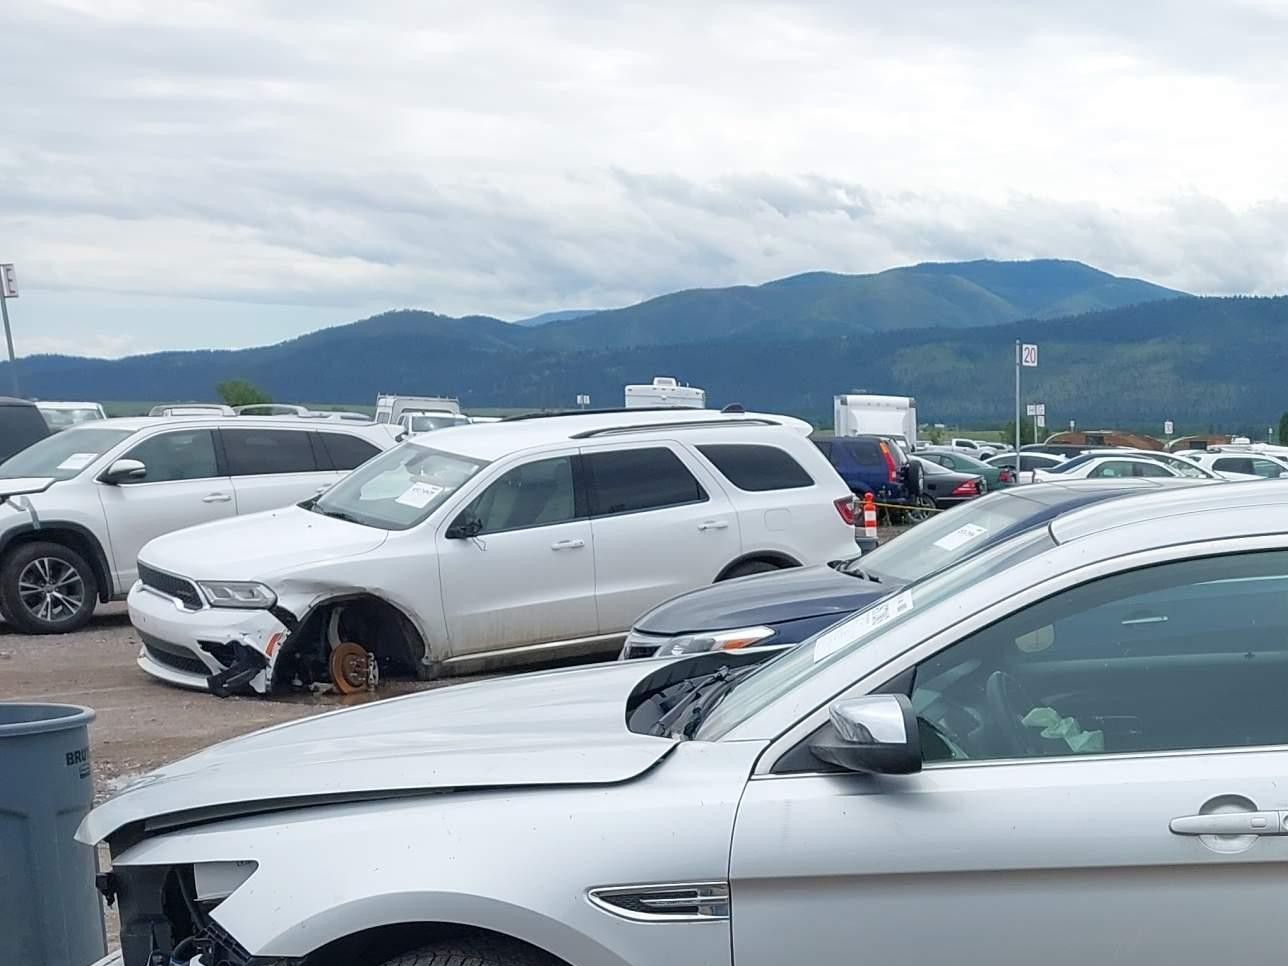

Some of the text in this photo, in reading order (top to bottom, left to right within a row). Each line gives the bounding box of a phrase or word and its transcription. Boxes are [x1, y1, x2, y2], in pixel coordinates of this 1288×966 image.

[6, 267, 16, 294] E
[1023, 347, 1036, 364] 20
[65, 746, 89, 766] BRU
